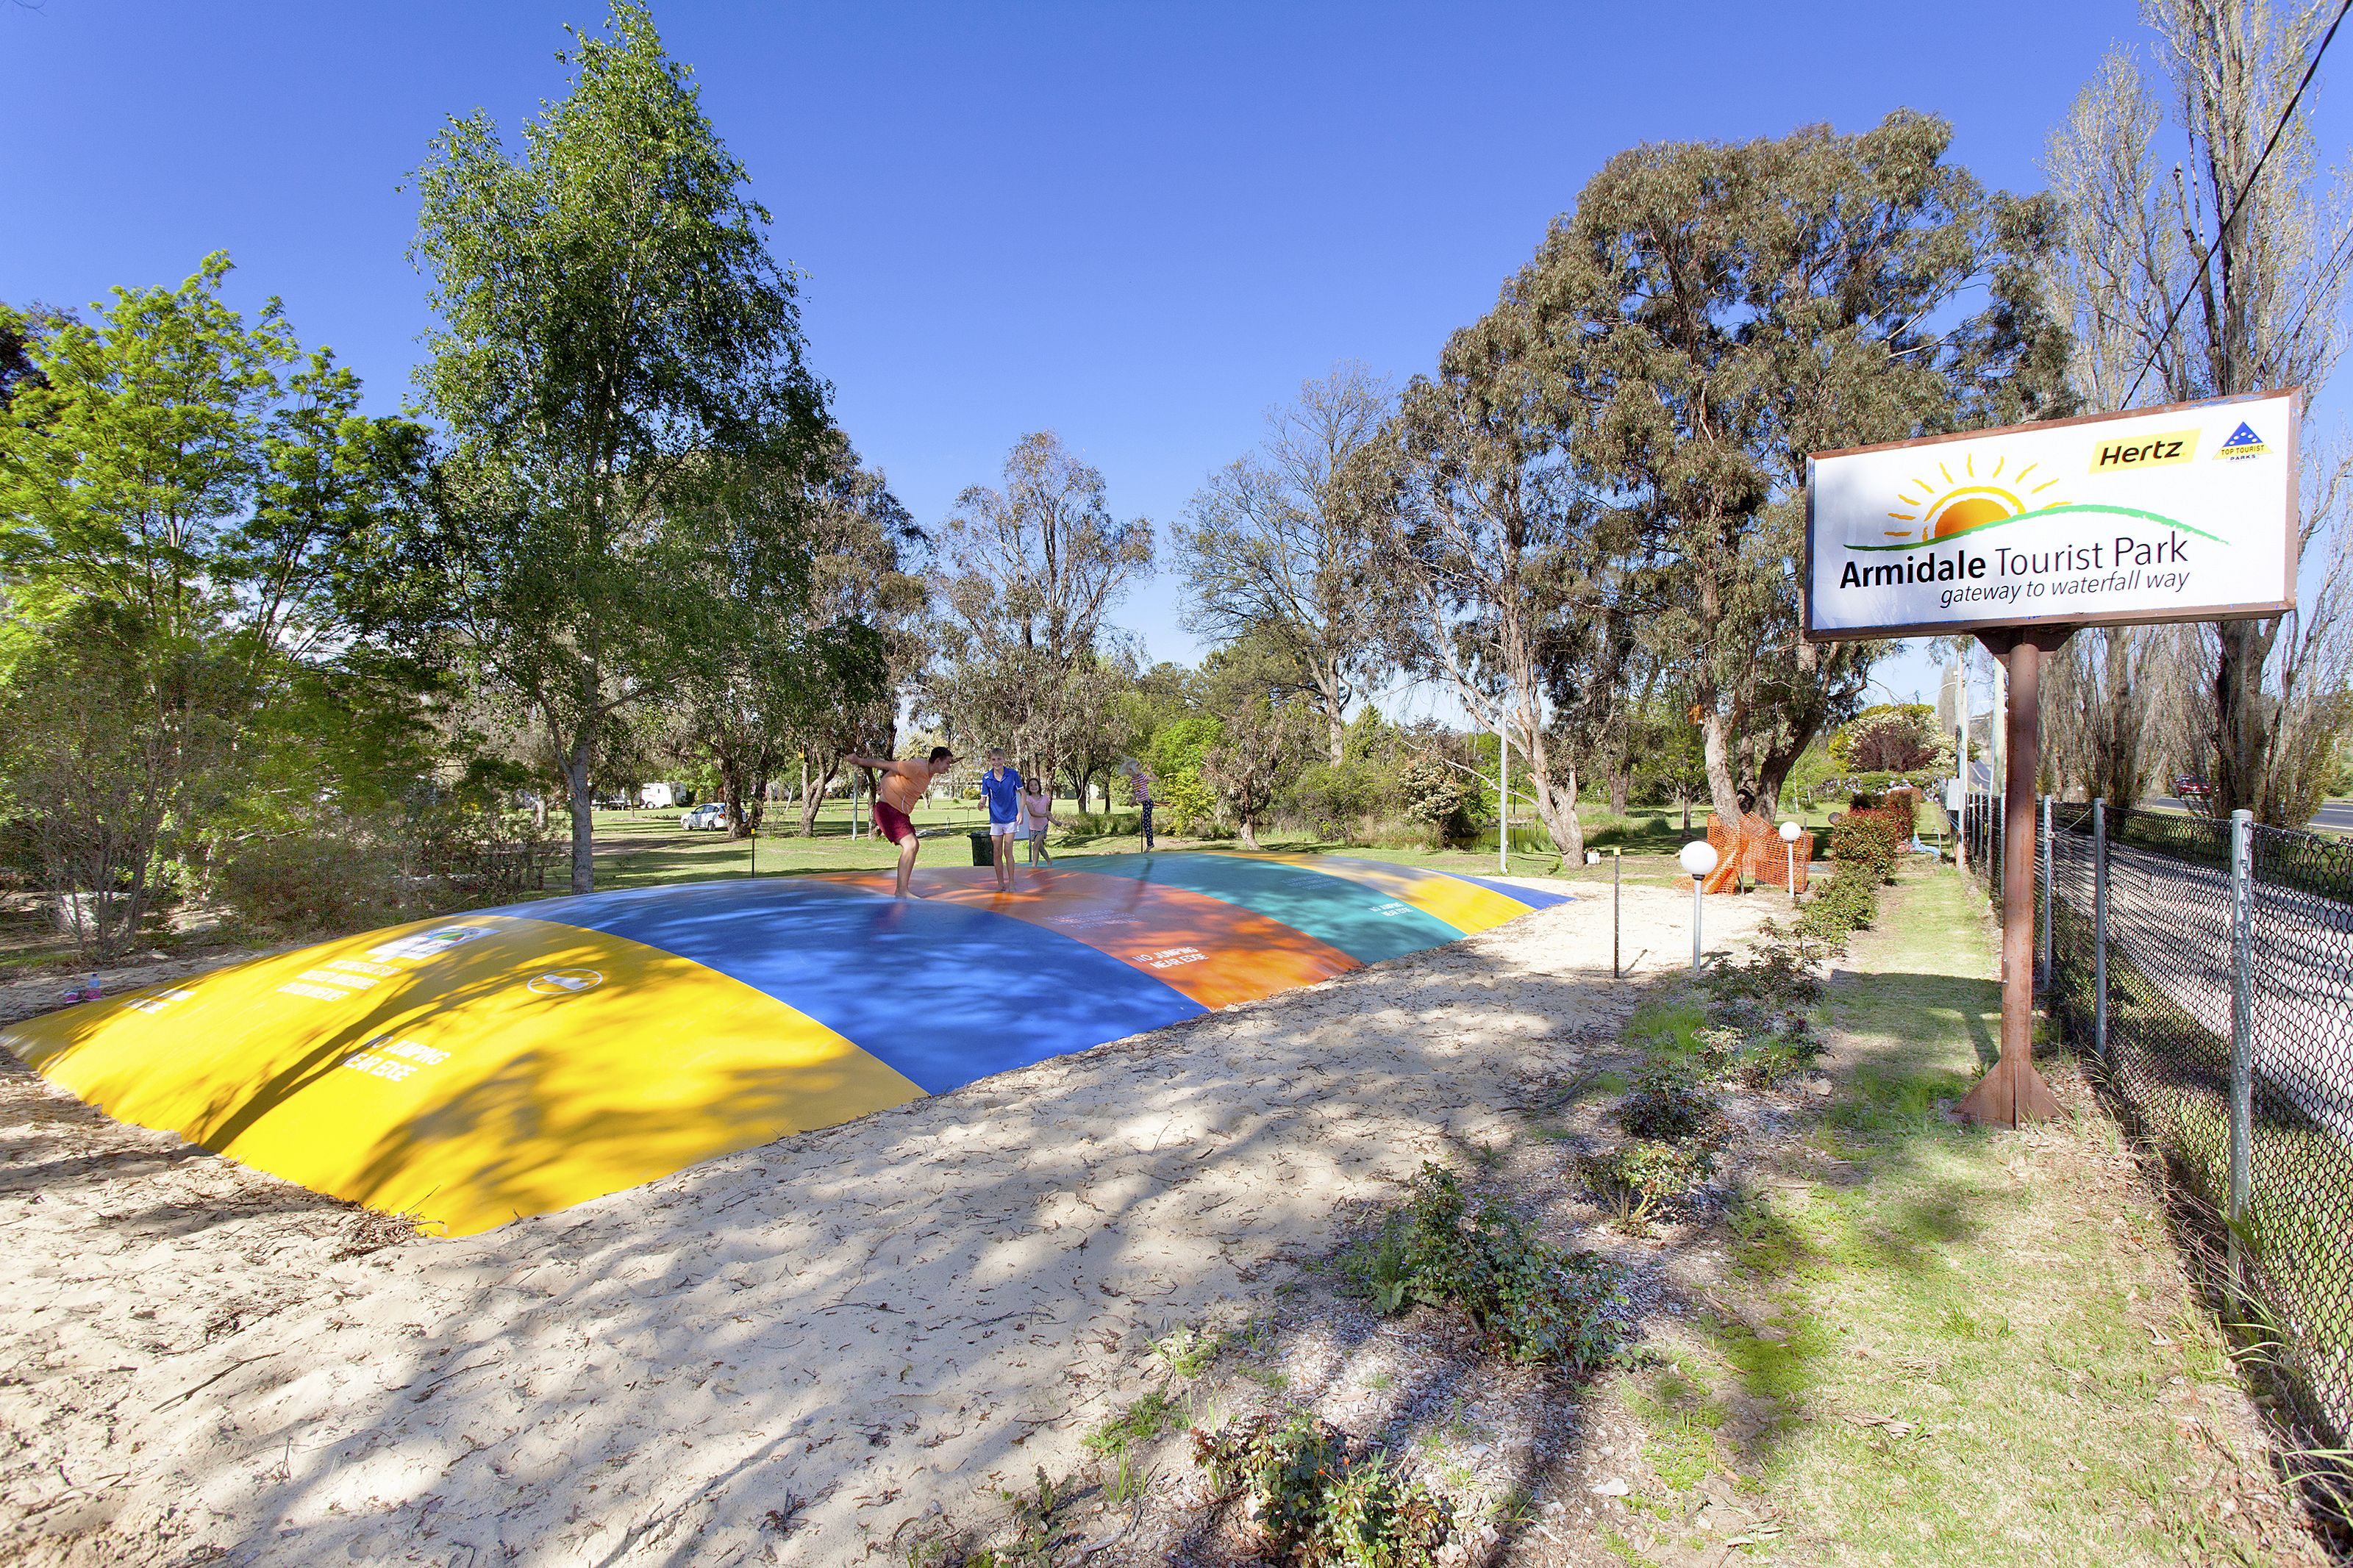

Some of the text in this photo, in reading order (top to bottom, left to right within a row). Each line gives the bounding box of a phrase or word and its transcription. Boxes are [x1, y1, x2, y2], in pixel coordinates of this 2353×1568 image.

[2099, 441, 2183, 465] Hertz
[2236, 445, 2265, 454] TOURIST
[1840, 531, 2188, 588] Armidale Tourist Park
[1940, 570, 2190, 608] gateway to waterfall way
[1133, 947, 1199, 963] NO JUMPING
[1151, 953, 1209, 969] NEAR EDGE
[362, 1034, 451, 1065] NO JUMPING
[338, 1051, 418, 1082] NEAR EDGE
